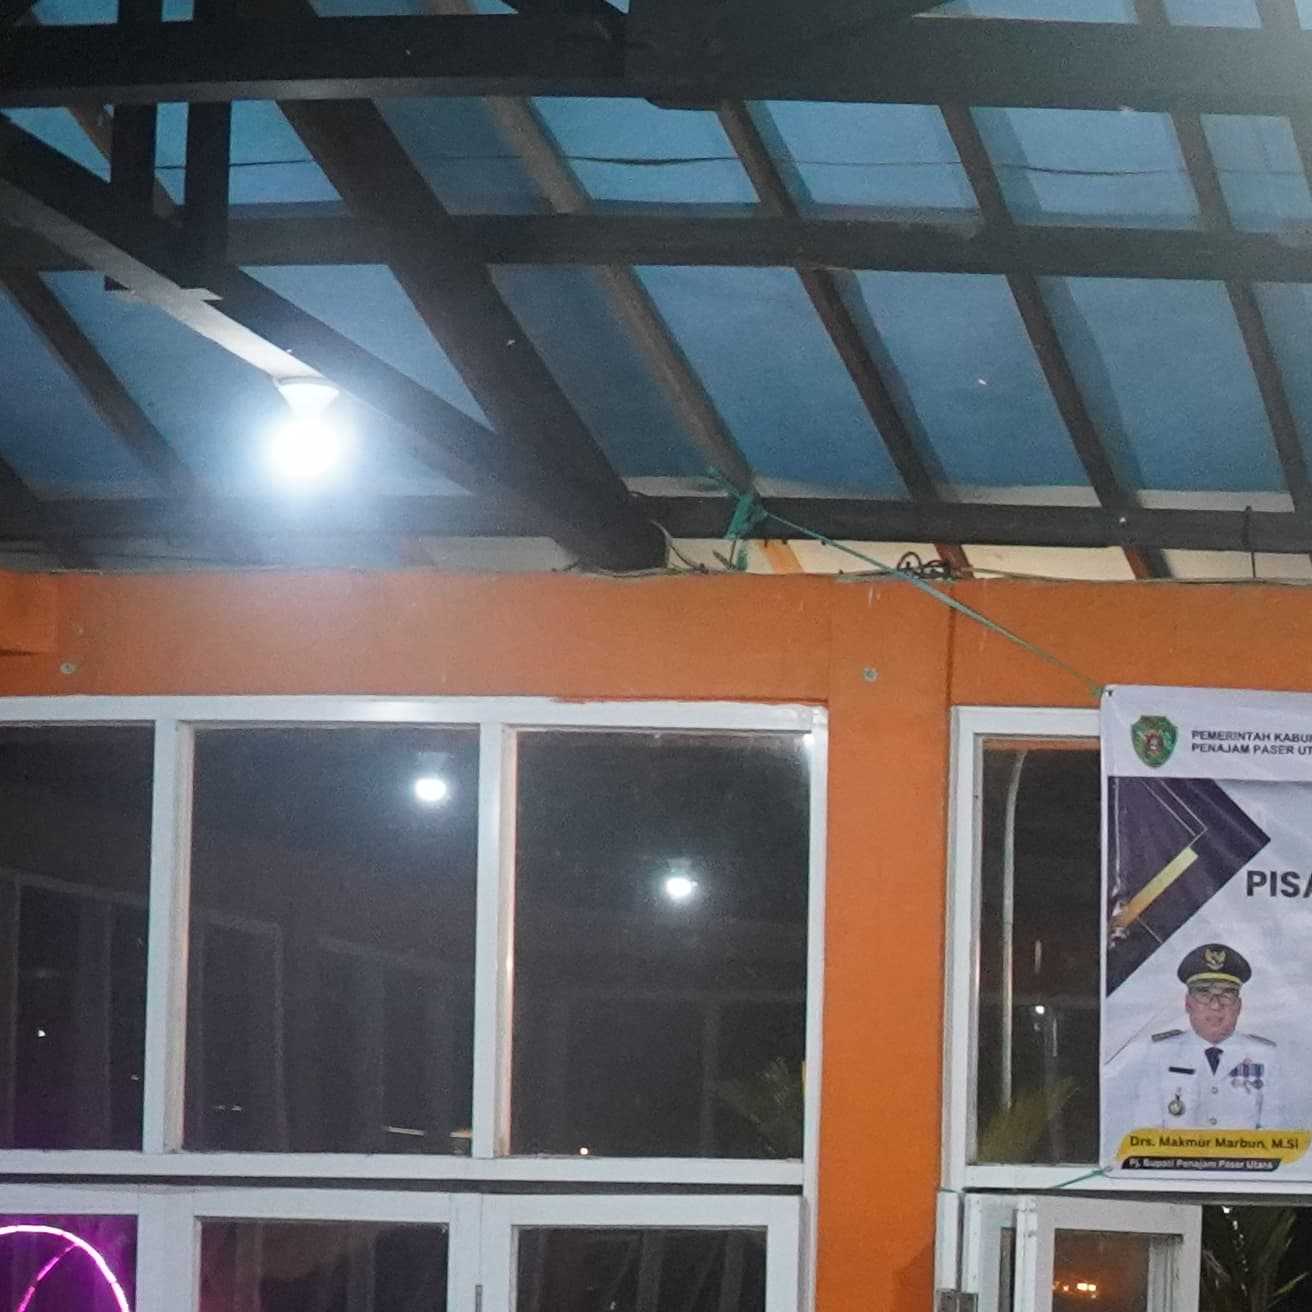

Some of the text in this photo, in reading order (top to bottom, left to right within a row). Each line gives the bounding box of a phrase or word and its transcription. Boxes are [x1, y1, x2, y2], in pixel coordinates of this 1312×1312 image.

[1191, 730, 1270, 742] PEMERINTAH
[1191, 743, 1250, 754] PENAJAM
[1253, 744, 1294, 755] PASER
[1130, 1135, 1156, 1147] Drs.
[1159, 1135, 1211, 1148] Makmur
